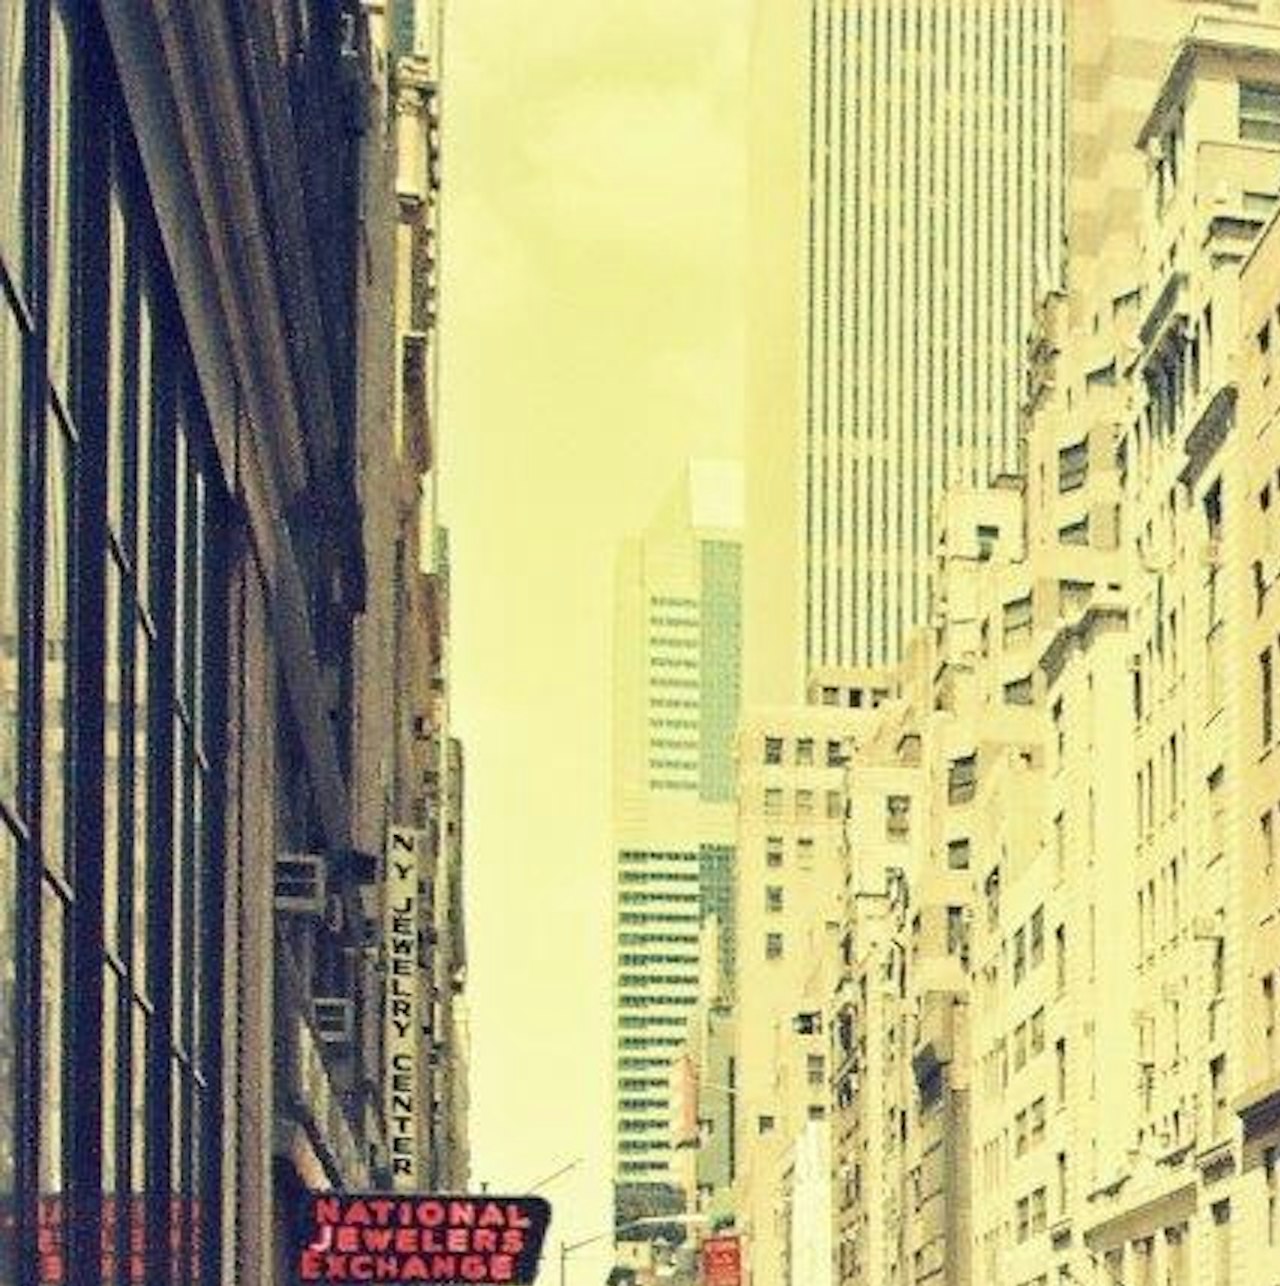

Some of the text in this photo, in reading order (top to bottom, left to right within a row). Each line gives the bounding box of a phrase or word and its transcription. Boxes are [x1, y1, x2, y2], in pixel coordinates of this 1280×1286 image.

[392, 896, 413, 1038] JEWELRY
[392, 1054, 413, 1176] CENTER
[316, 1199, 531, 1229] NATIONAL
[308, 1224, 525, 1254] JEWELERS
[299, 1247, 514, 1281] EXCHANGE
